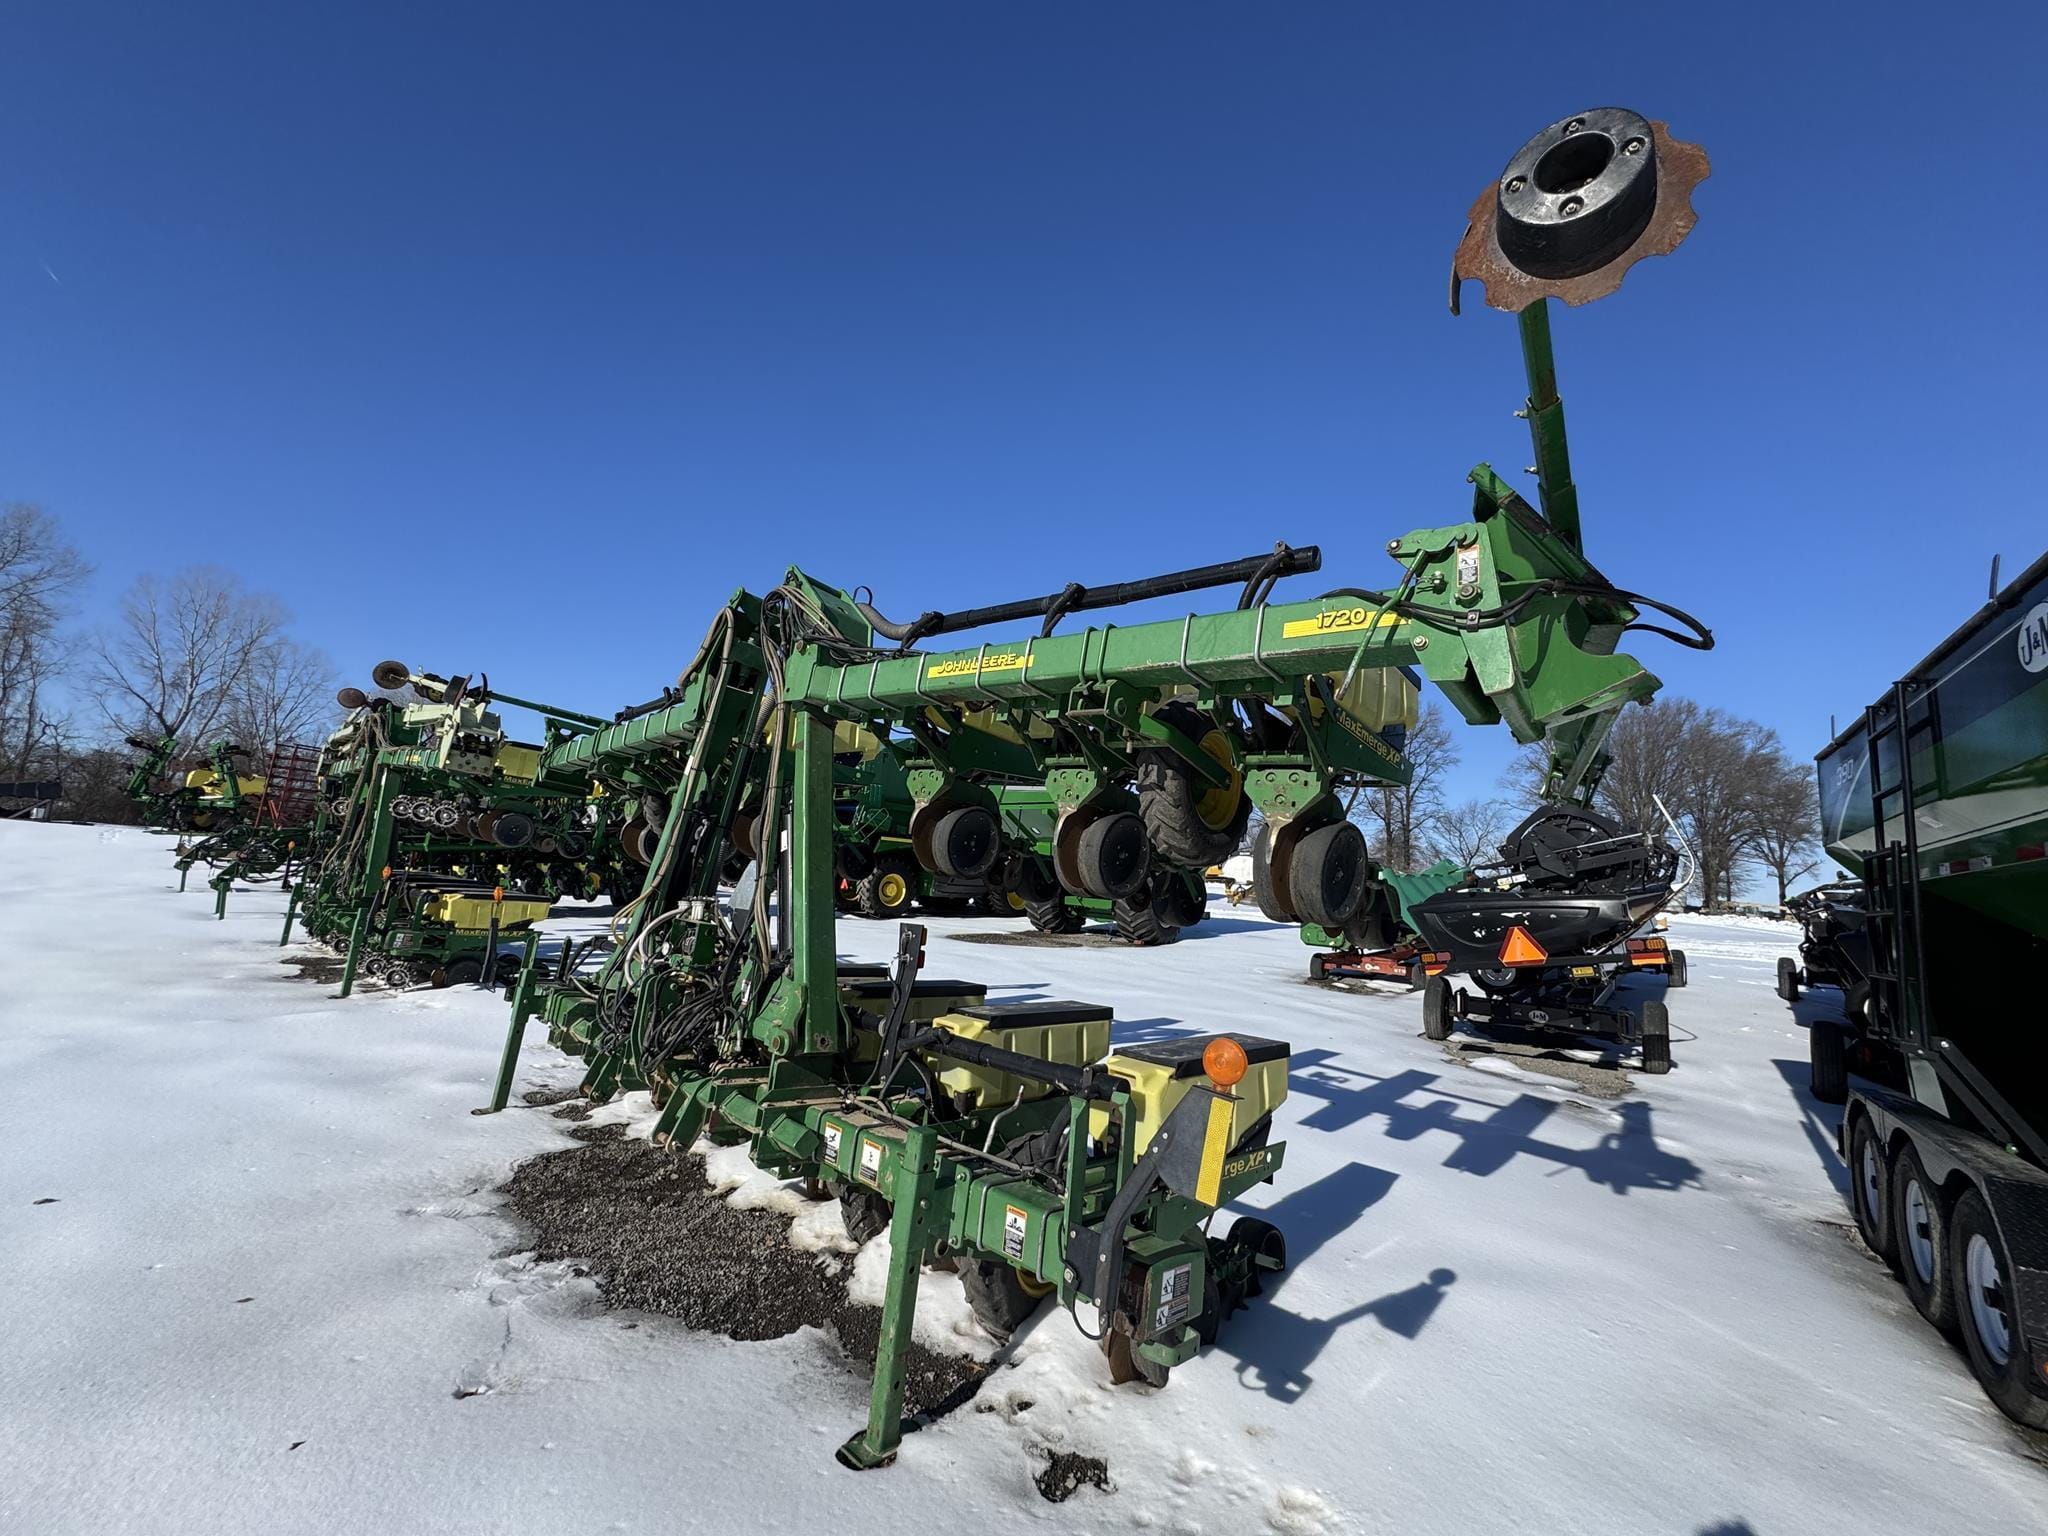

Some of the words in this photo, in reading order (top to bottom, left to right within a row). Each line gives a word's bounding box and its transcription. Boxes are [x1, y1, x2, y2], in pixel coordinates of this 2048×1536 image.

[1315, 607, 1367, 629] 1720
[937, 657, 972, 674] JOHN
[1386, 748, 1402, 764] XP
[1243, 1150, 1265, 1172] XP
